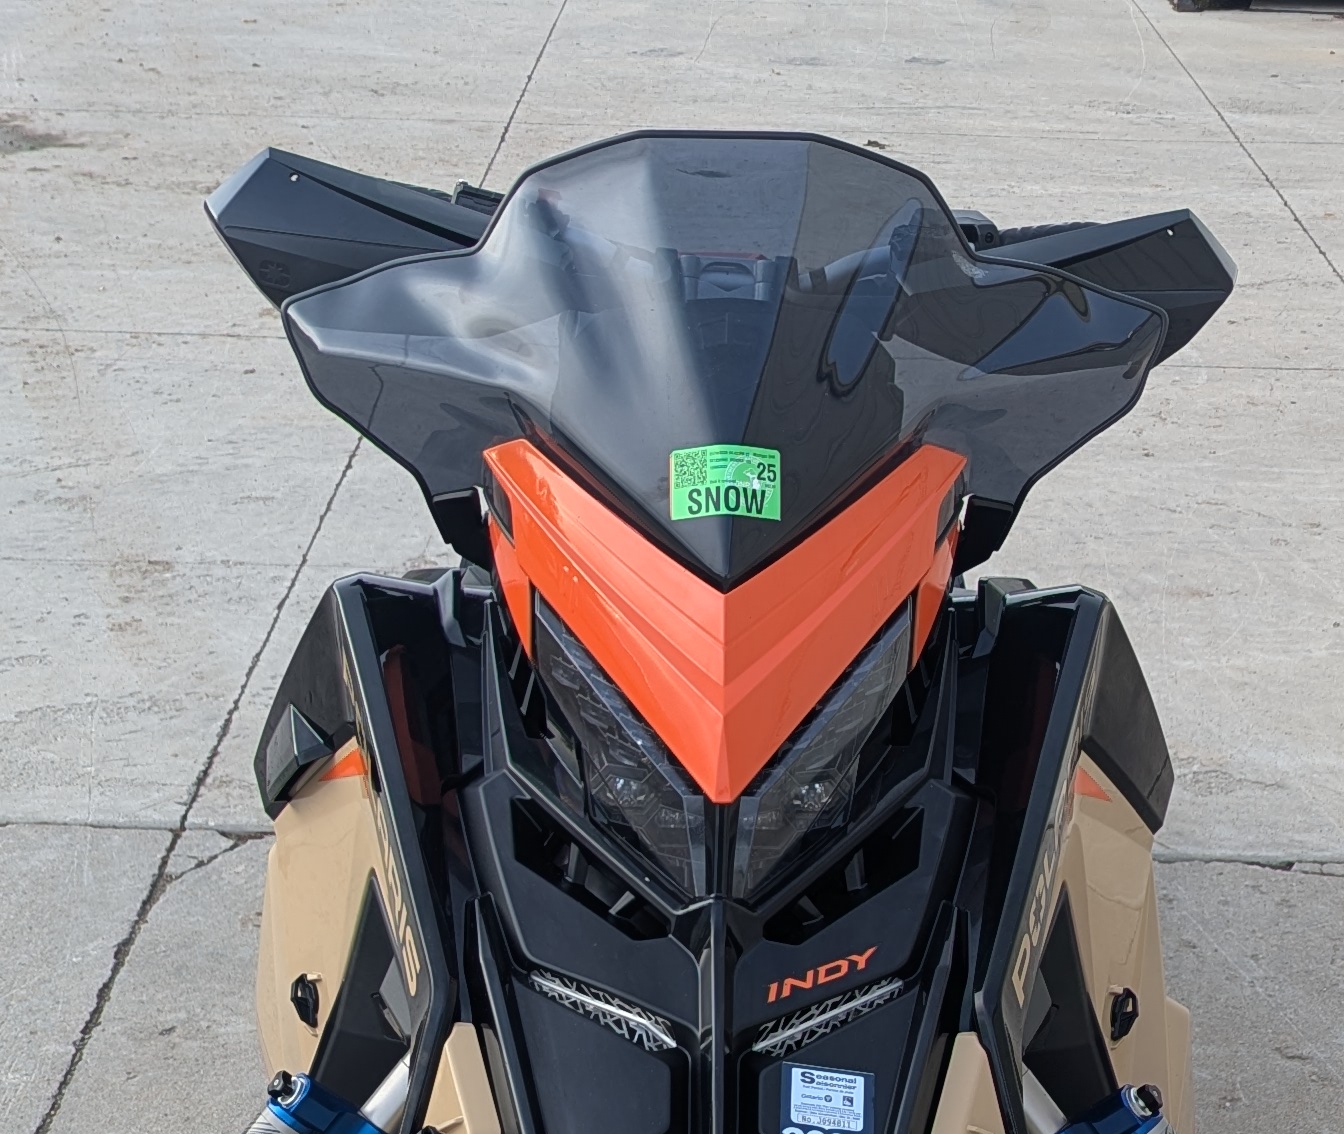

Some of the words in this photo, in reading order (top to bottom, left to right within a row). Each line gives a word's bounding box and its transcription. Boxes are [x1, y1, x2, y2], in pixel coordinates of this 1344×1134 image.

[756, 462, 777, 482] 25
[687, 485, 766, 515] SNOW
[766, 945, 879, 1004] INDY
[799, 1071, 857, 1085] Seasonal
